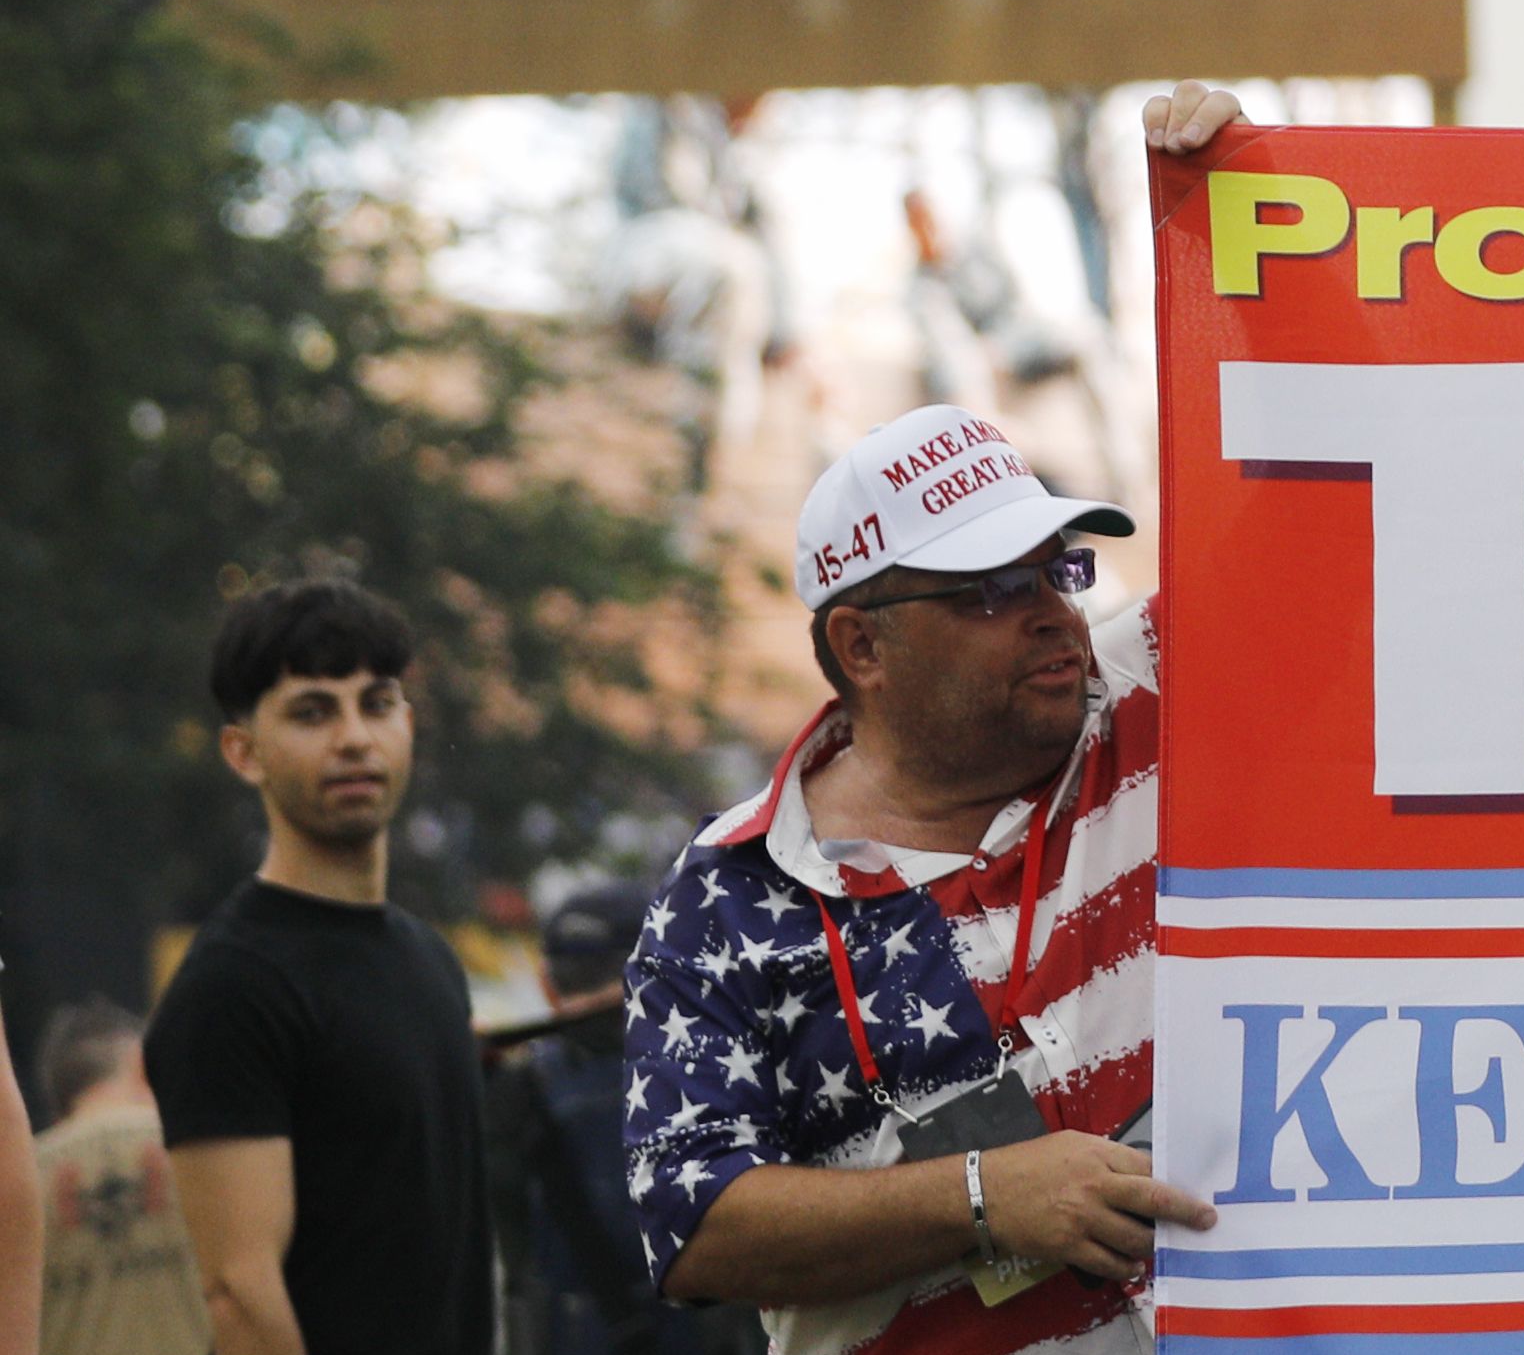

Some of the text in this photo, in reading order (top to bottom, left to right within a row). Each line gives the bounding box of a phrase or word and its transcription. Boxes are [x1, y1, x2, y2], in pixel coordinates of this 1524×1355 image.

[880, 430, 963, 493] MAKE
[921, 455, 1002, 516] GREAT
[813, 512, 887, 589] 45-47
